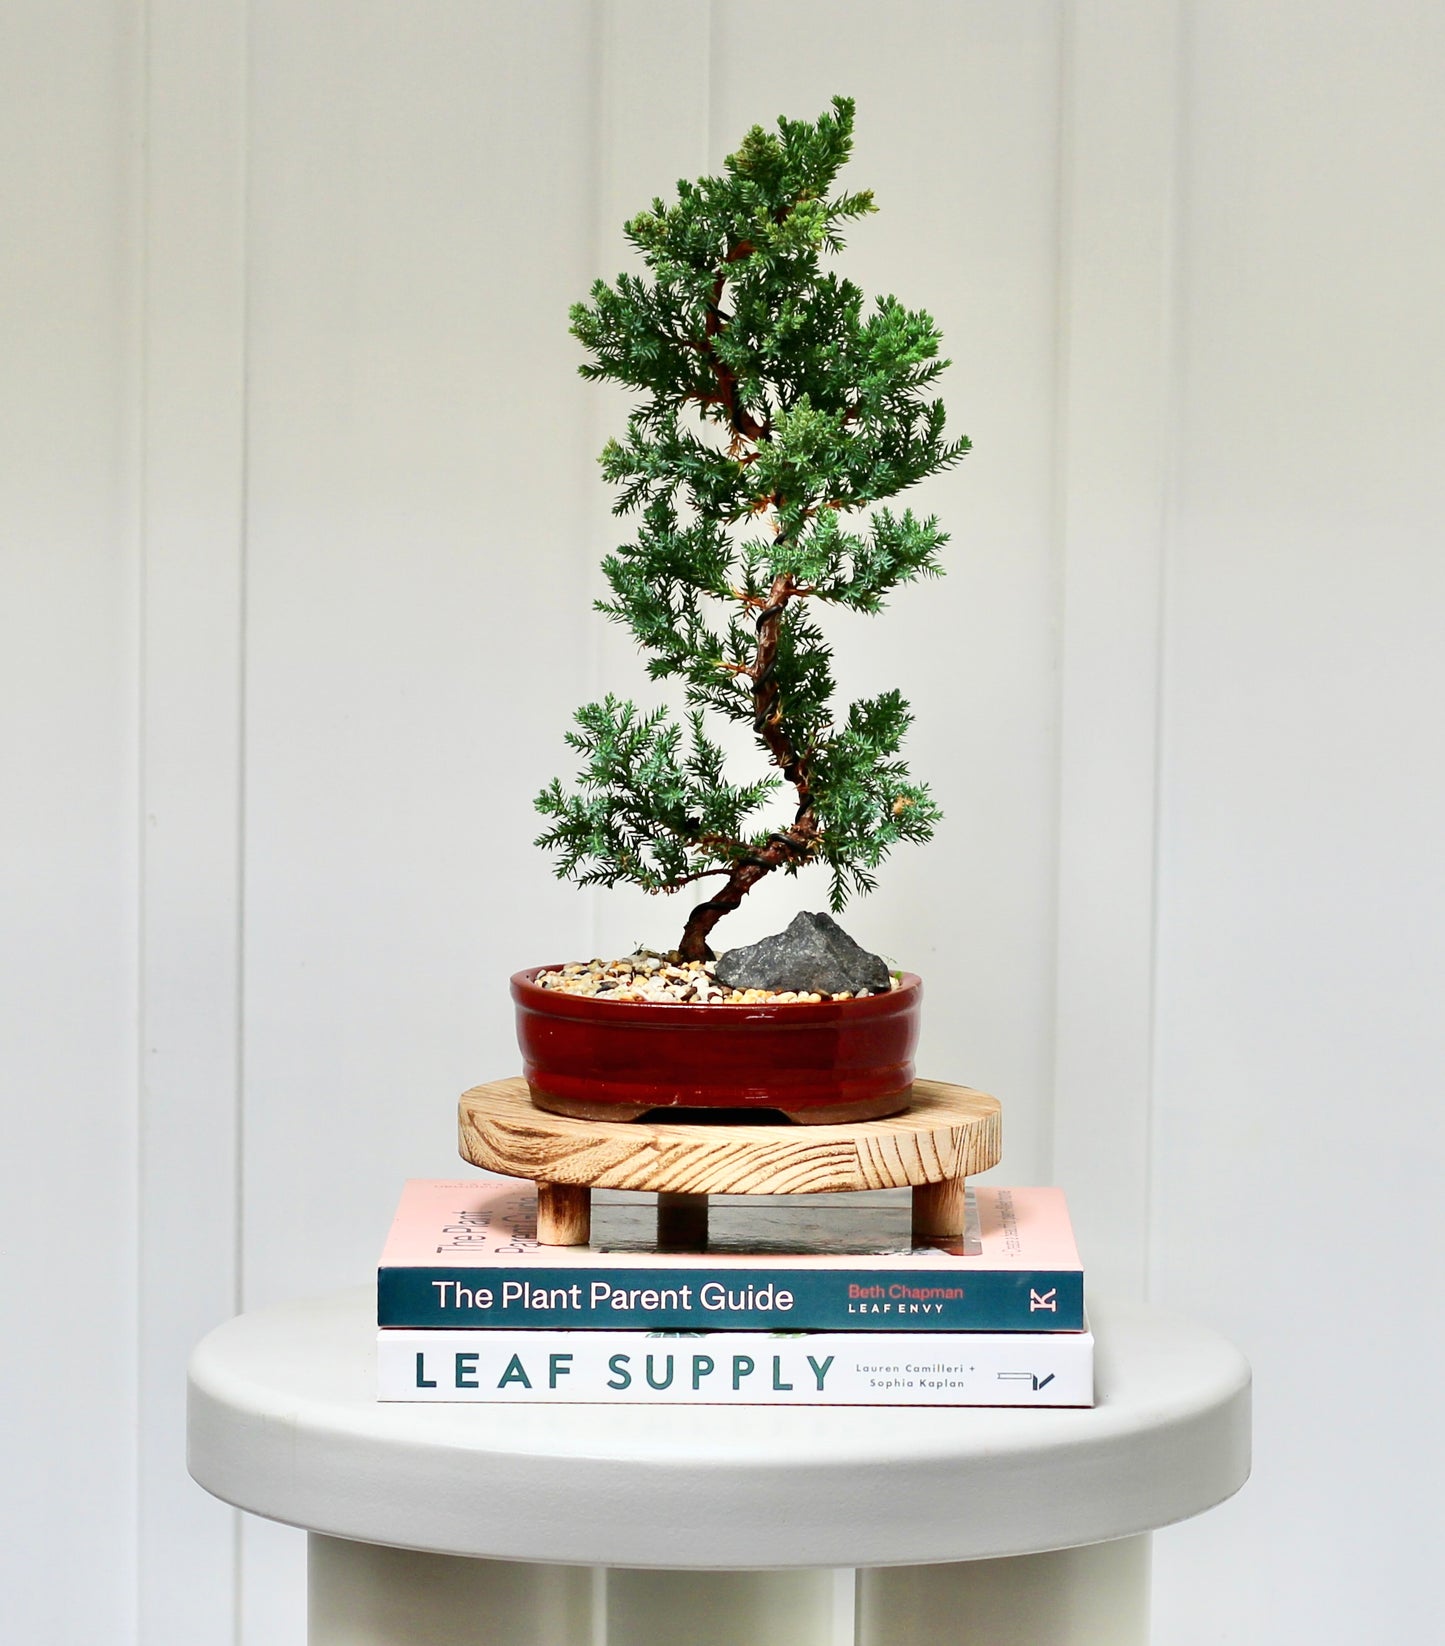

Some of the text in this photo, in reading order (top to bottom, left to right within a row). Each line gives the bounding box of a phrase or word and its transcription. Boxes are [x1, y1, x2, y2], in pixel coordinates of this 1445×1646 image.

[442, 1210, 493, 1233] Plant
[436, 1235, 486, 1254] The
[431, 1281, 794, 1311] The Plant Parent Guide
[848, 1284, 964, 1302] Beth Chapman
[848, 1303, 944, 1314] LEAF ENVY
[416, 1352, 835, 1391] LEAF SUPPLY
[856, 1363, 900, 1373] Lauren
[905, 1363, 964, 1373] Camilleri
[870, 1378, 964, 1390] Sophia Kaplan
